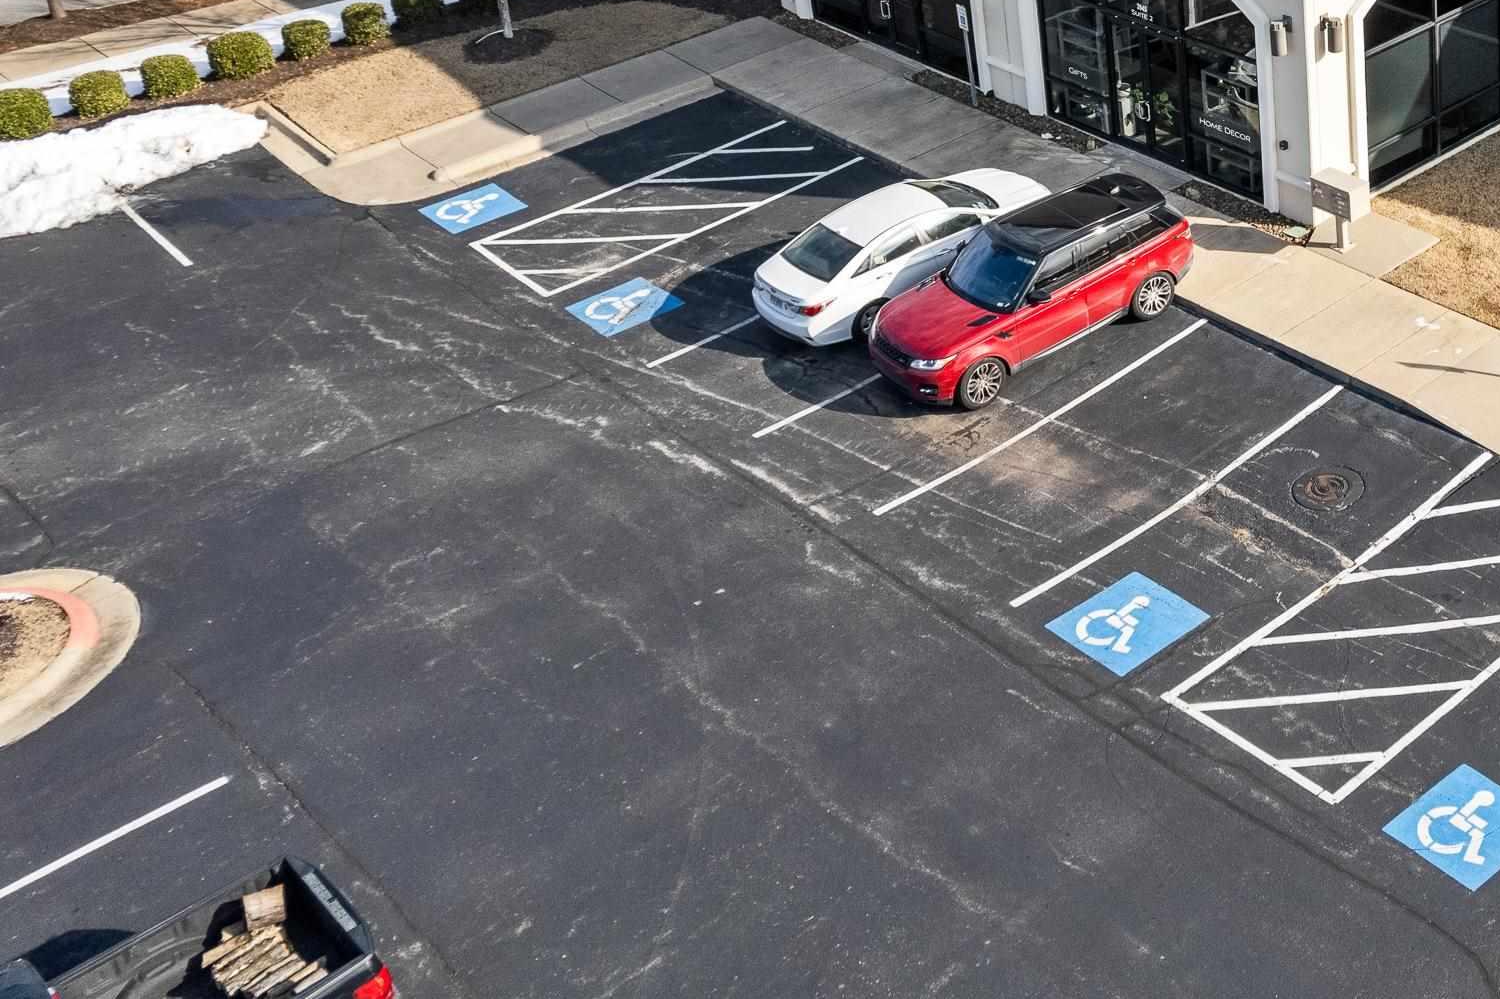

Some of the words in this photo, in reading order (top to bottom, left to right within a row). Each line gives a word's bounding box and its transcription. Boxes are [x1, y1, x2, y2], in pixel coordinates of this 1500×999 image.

[1131, 8, 1148, 21] SUITE
[1068, 66, 1088, 80] GIFTS
[1200, 117, 1223, 132] HOME
[1224, 127, 1251, 143] DECOR
